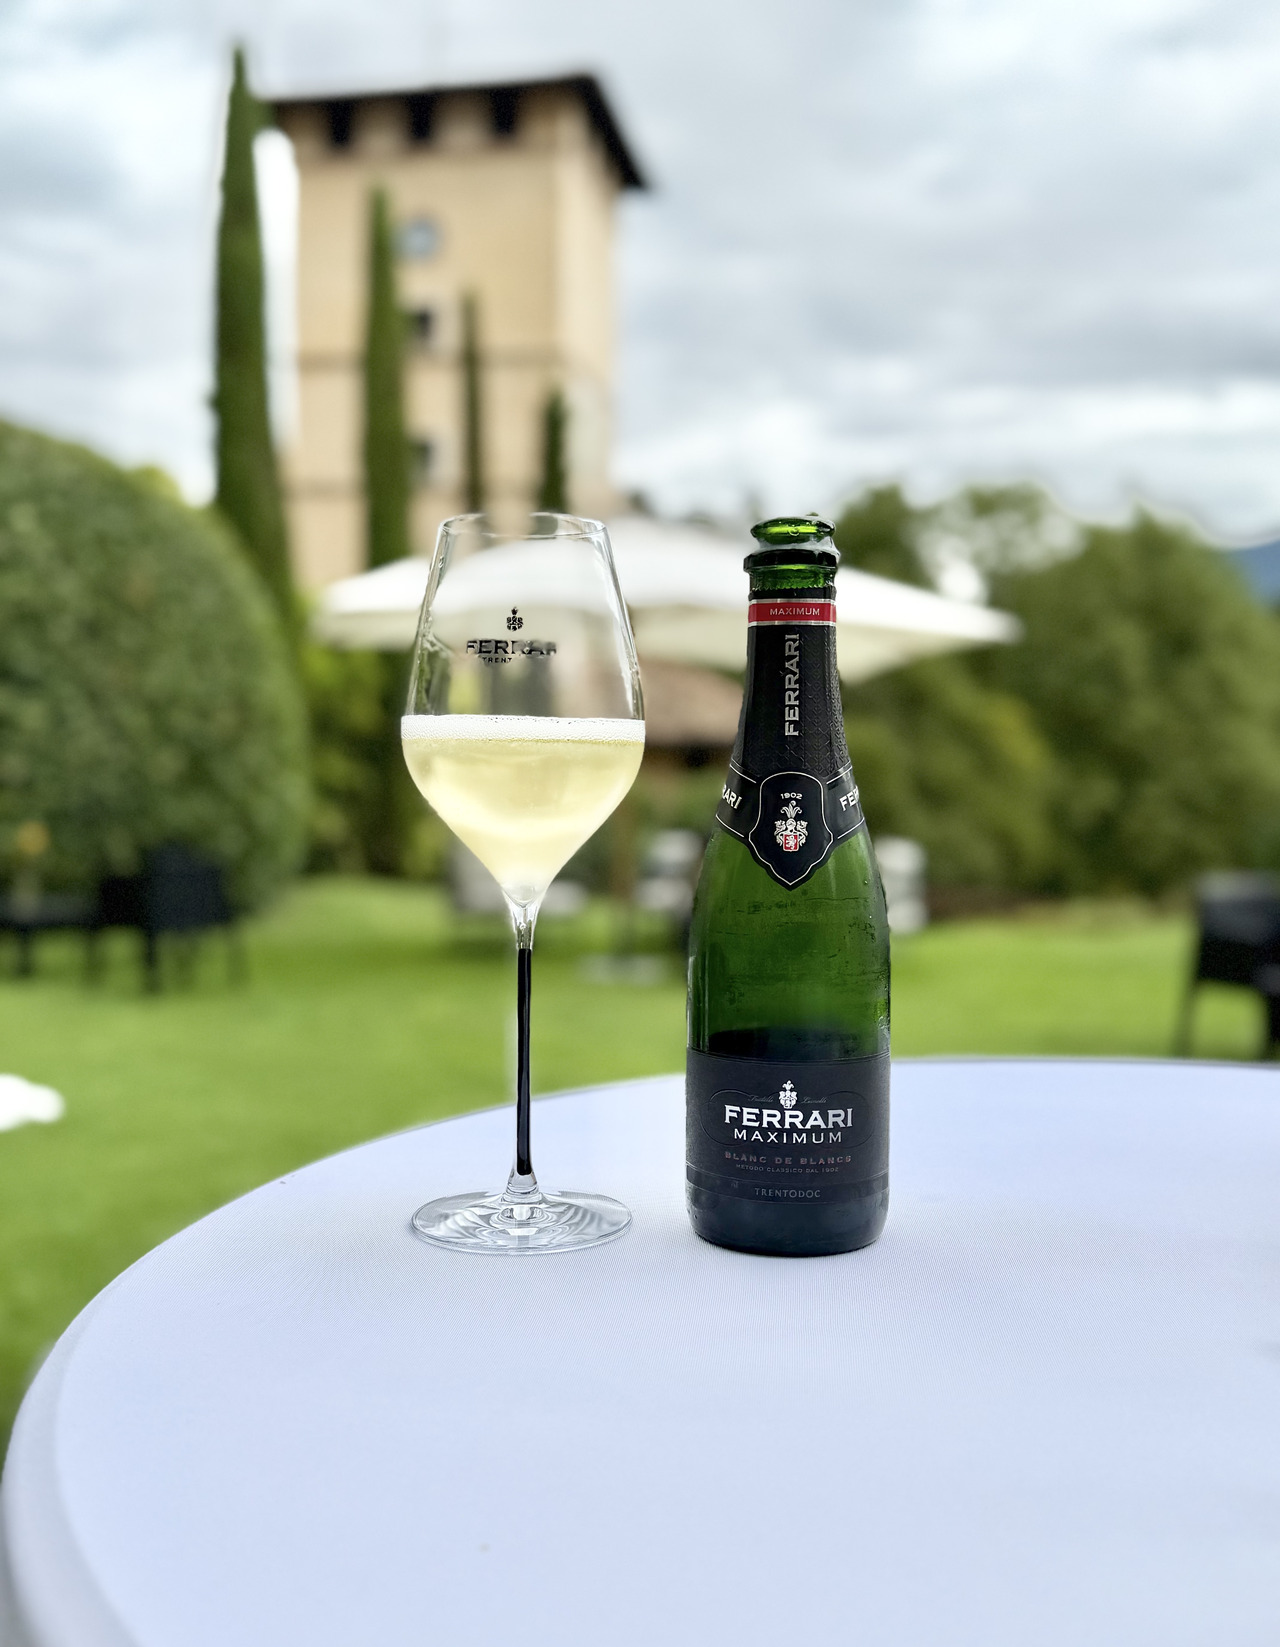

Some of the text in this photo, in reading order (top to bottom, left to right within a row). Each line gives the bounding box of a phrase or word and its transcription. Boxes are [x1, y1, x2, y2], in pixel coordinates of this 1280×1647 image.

[769, 607, 821, 616] MAXIMUM
[784, 633, 800, 737] FERRARI
[780, 792, 803, 800] 1902
[724, 1104, 853, 1129] FERRARI
[733, 1128, 843, 1144] MAXIMUM
[724, 1151, 852, 1165] BLANC DE BLANCS
[735, 1163, 764, 1171] METODO
[754, 1187, 821, 1199] TRENTODOC
